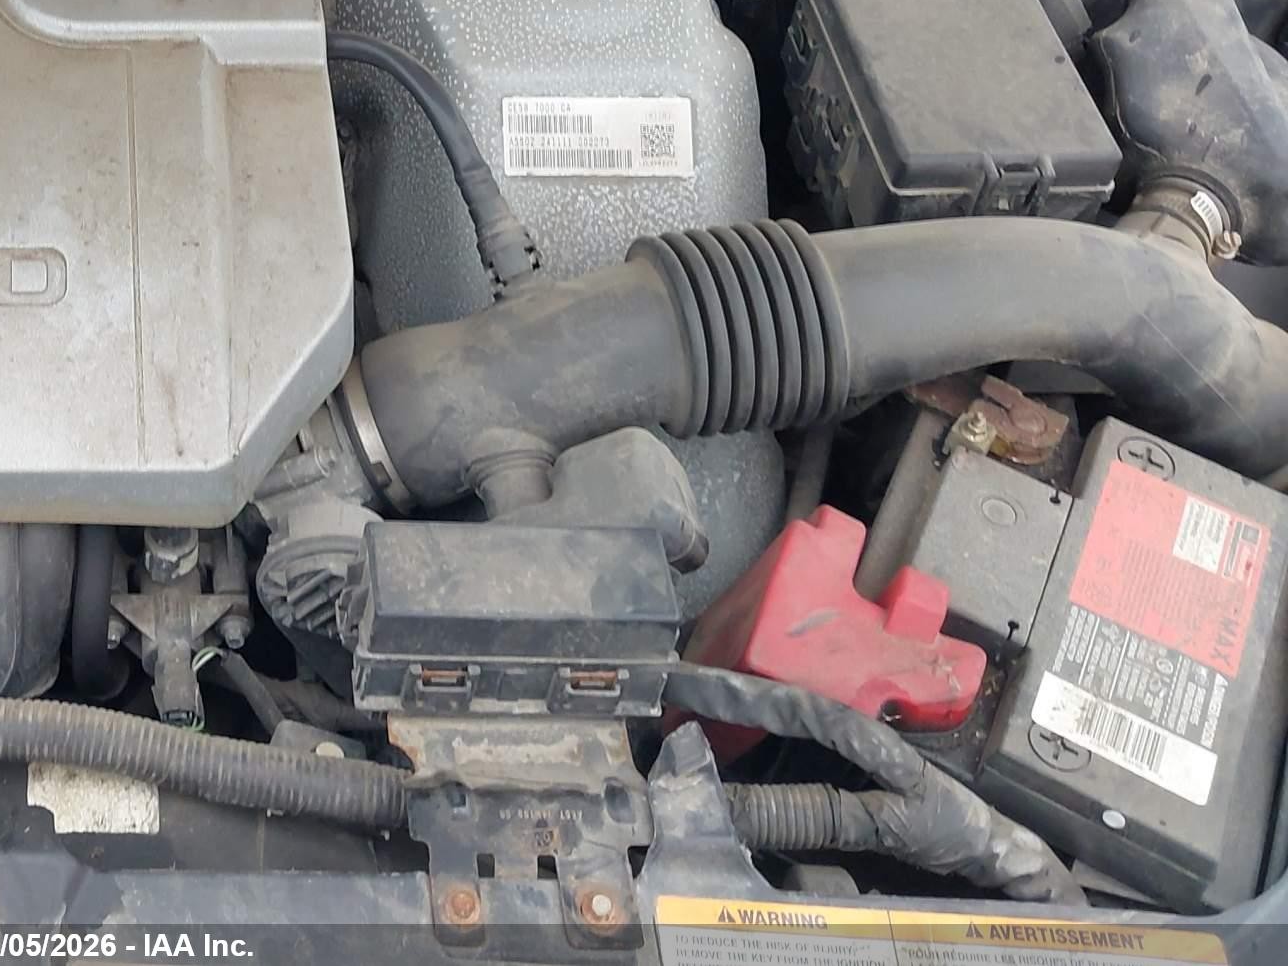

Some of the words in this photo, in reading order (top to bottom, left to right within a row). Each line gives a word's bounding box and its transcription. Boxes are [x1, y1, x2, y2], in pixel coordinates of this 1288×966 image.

[737, 908, 829, 931] WARNING
[691, 935, 739, 948] REDUCE
[741, 938, 762, 950] THE
[989, 923, 1146, 951] AVERTISSEMENT
